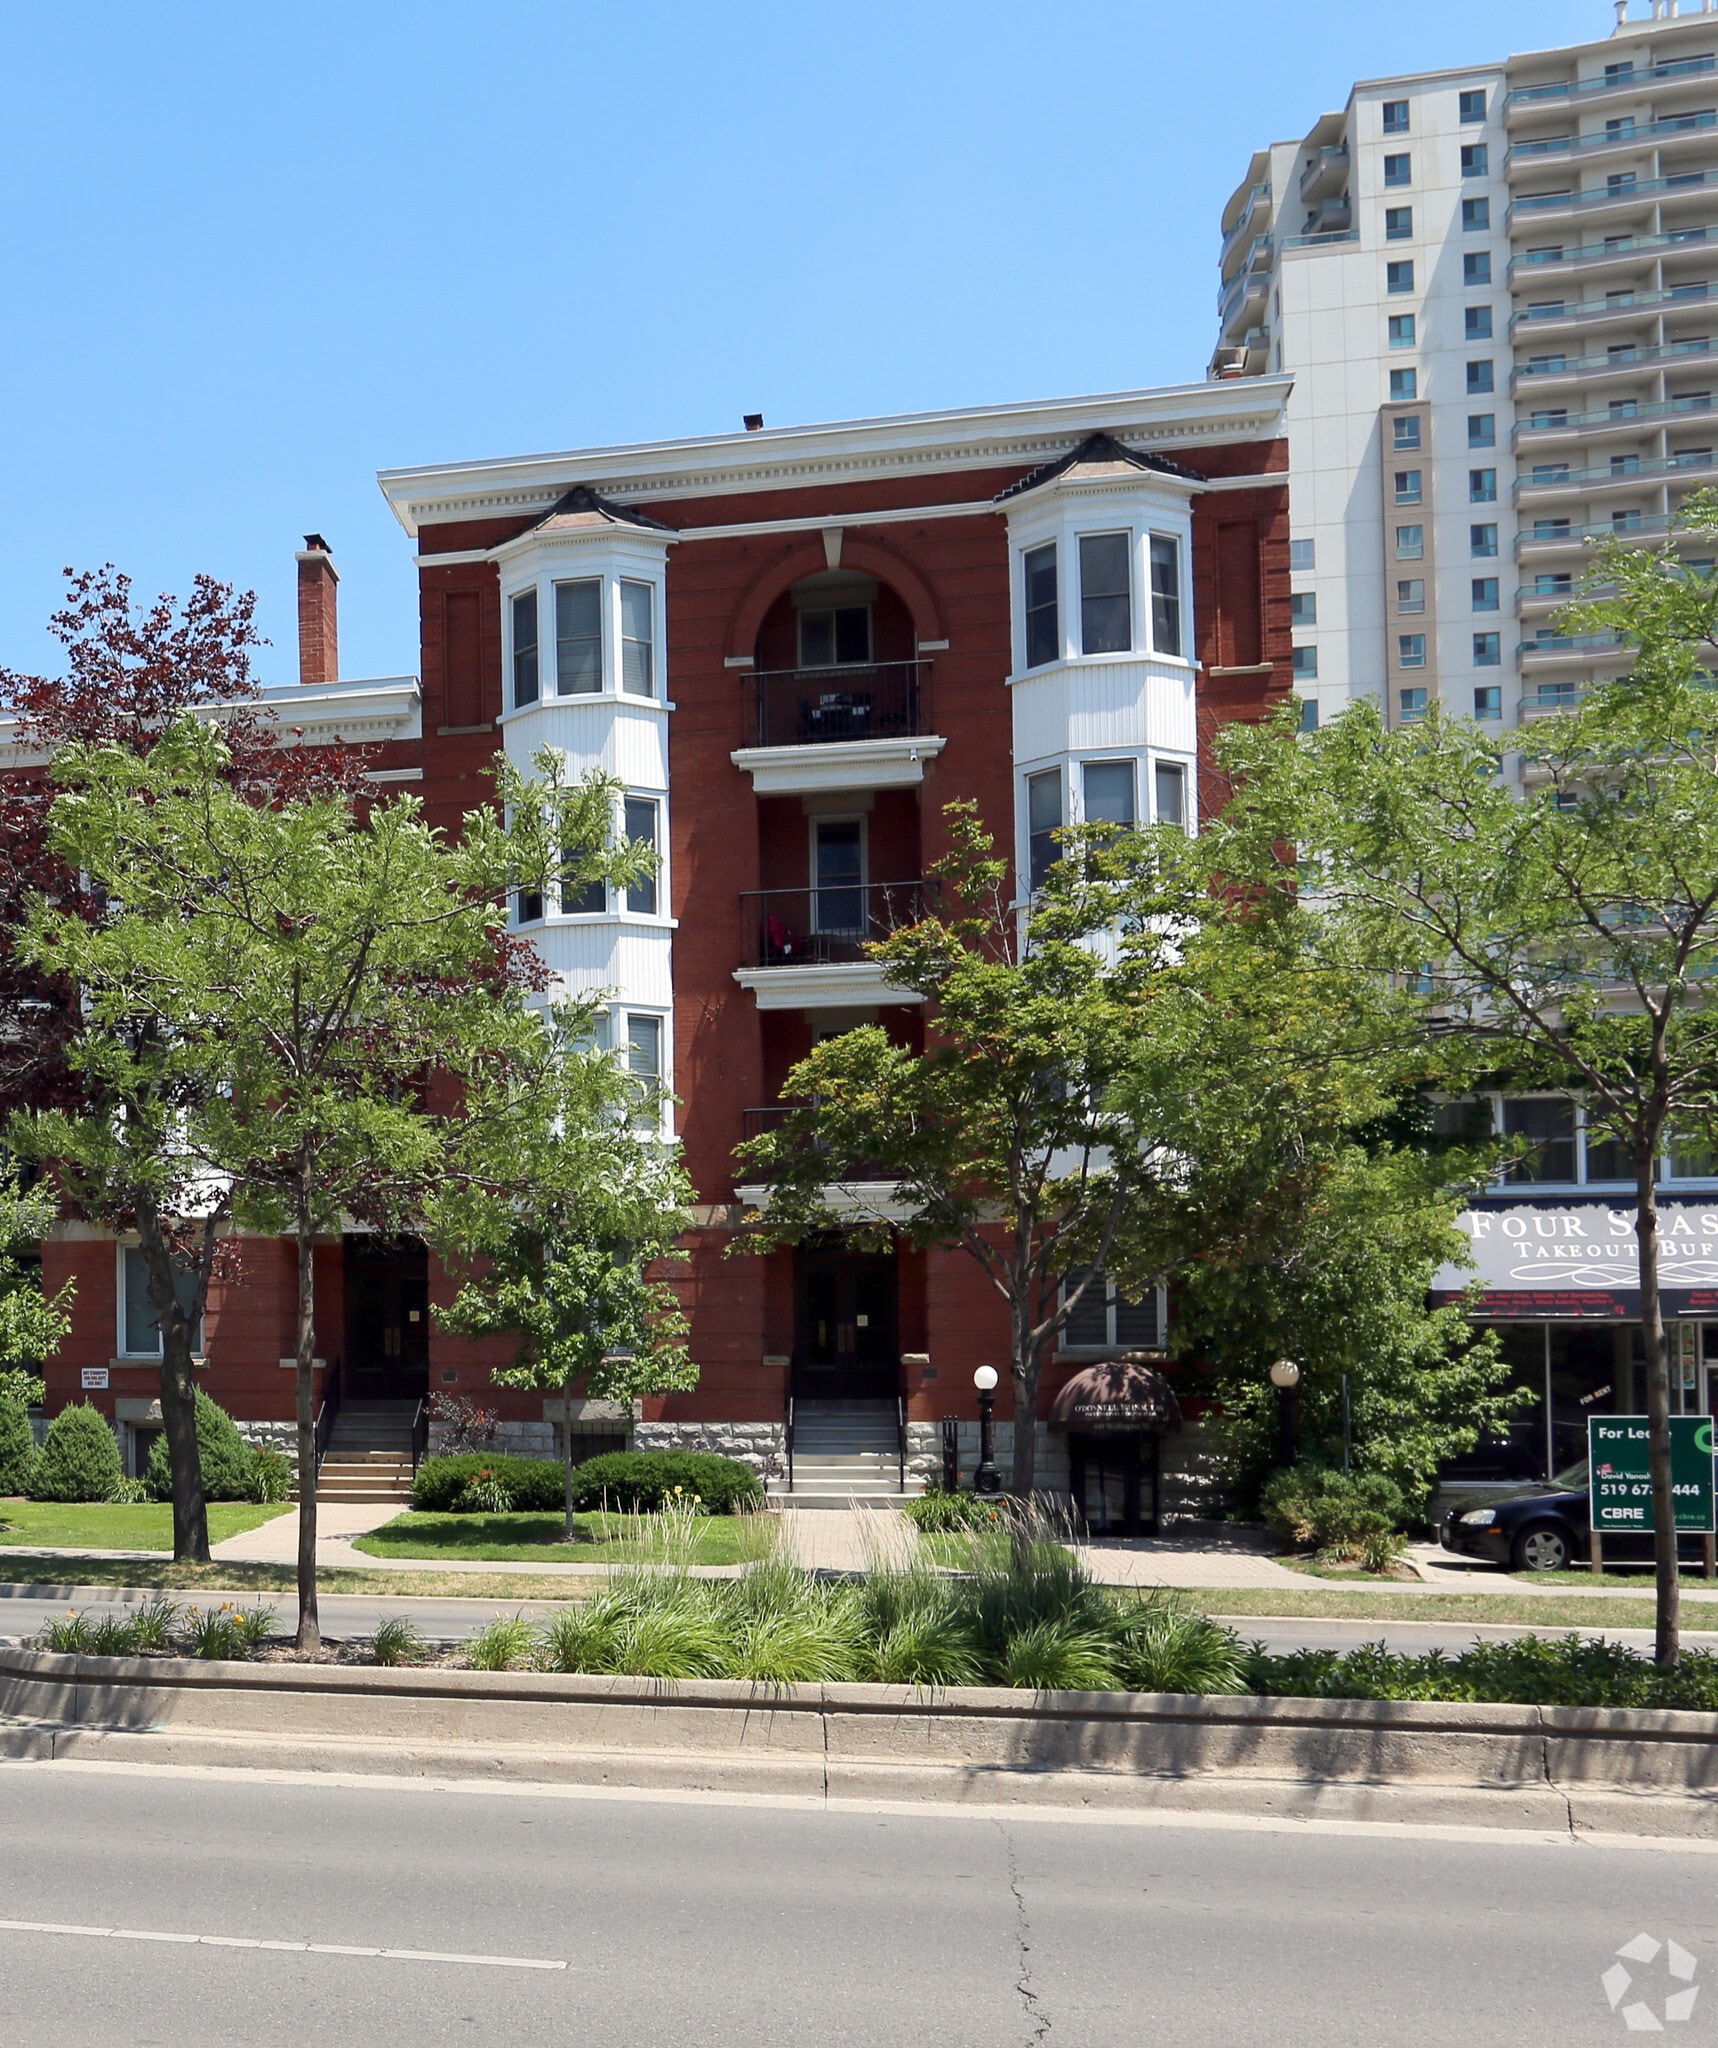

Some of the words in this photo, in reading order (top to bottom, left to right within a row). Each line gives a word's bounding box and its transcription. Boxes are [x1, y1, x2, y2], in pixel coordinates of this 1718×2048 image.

[1471, 1211, 1588, 1239] FOUR
[1513, 1241, 1638, 1258] TAKEOUT
[1599, 1427, 1623, 1439] For
[1600, 1484, 1627, 1496] 519
[1667, 1484, 1700, 1496] 444
[1601, 1508, 1644, 1519] CBRE
